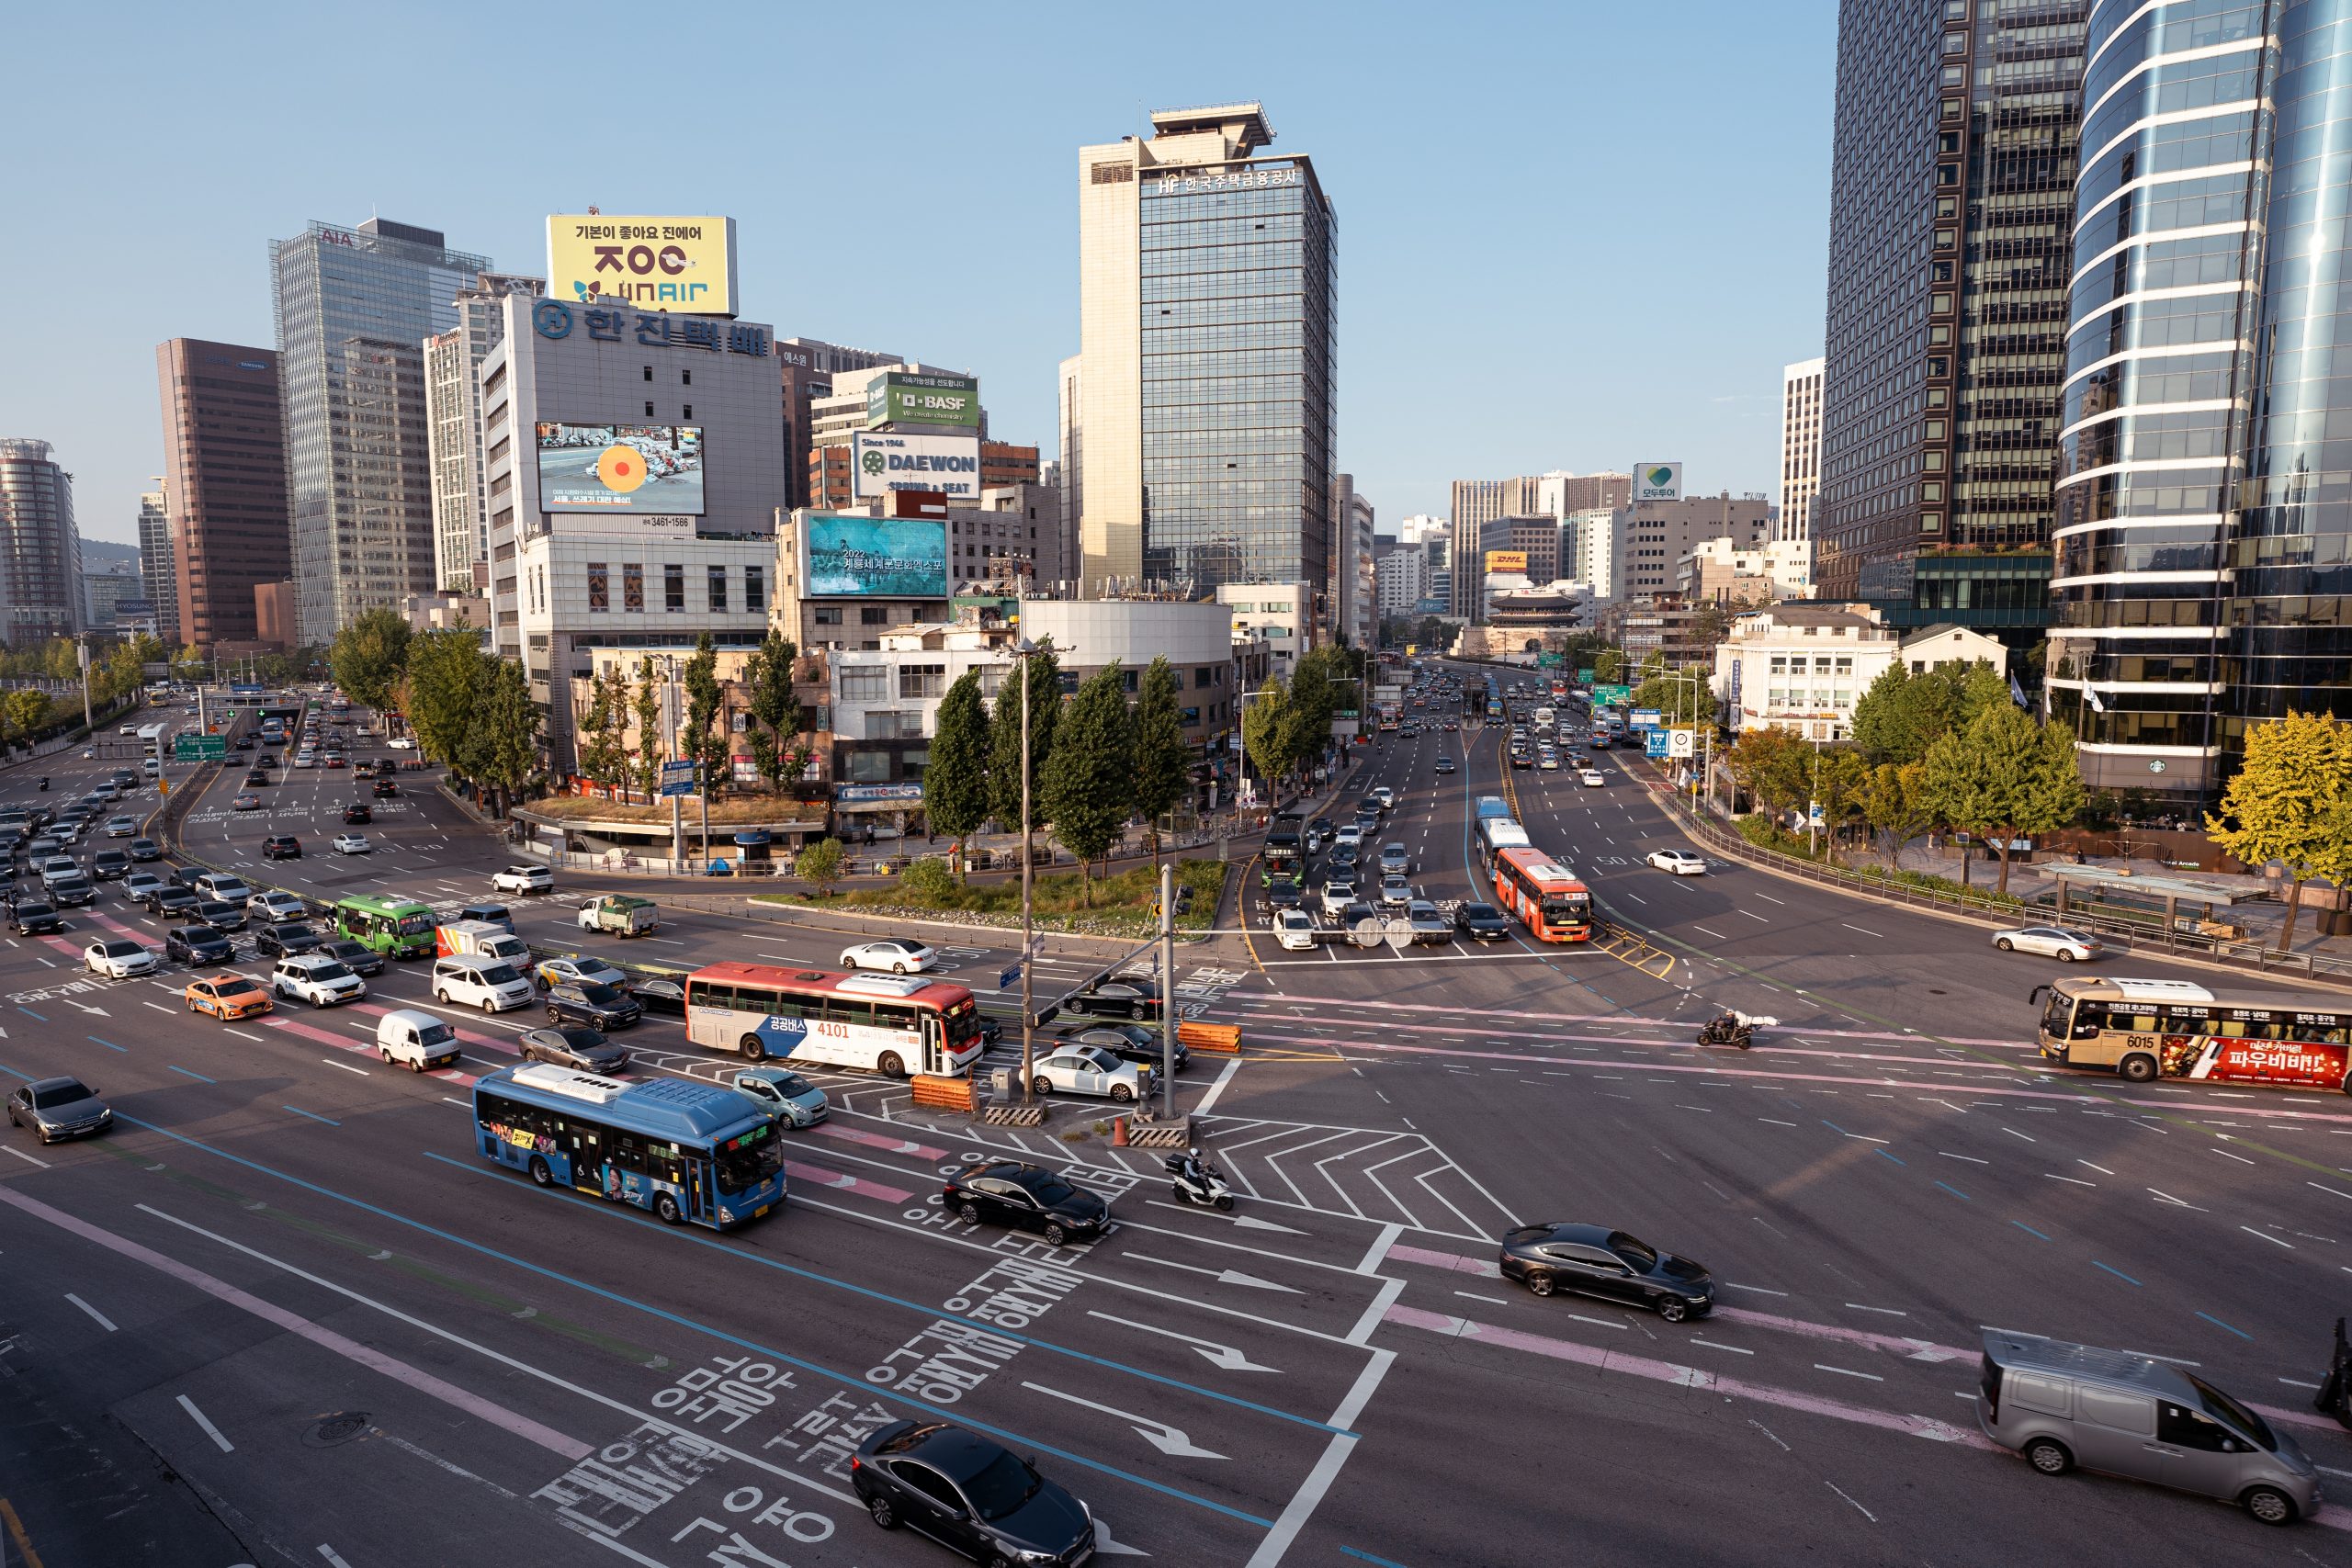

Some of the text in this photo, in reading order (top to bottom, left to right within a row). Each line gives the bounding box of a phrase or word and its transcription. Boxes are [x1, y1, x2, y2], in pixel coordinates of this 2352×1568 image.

[1159, 169, 1296, 195] HF 한국주택금융공사
[322, 230, 353, 247] AIA
[576, 225, 702, 241] 기본이 좋아요 진에어
[584, 309, 767, 357] 한진택배
[784, 351, 807, 367] 에스원
[901, 376, 966, 389] 지속가능성을 선도합니다
[924, 395, 966, 411] BASF
[933, 412, 964, 422] chemistry
[862, 438, 905, 448] Since 1946
[888, 454, 976, 473] DAEWON
[888, 481, 929, 492] SPRING
[942, 482, 970, 494] SEAT
[1643, 489, 1675, 498] 모두투어
[553, 496, 571, 504] 서울,
[572, 496, 595, 504] 쓰레기
[651, 517, 688, 527] 3461-1566
[842, 549, 865, 558] 2022
[842, 558, 943, 571] 계룡세계군문화엑스포
[770, 1016, 806, 1033] 공공버스
[817, 1022, 850, 1039] 4101
[2127, 1035, 2154, 1049] 6015
